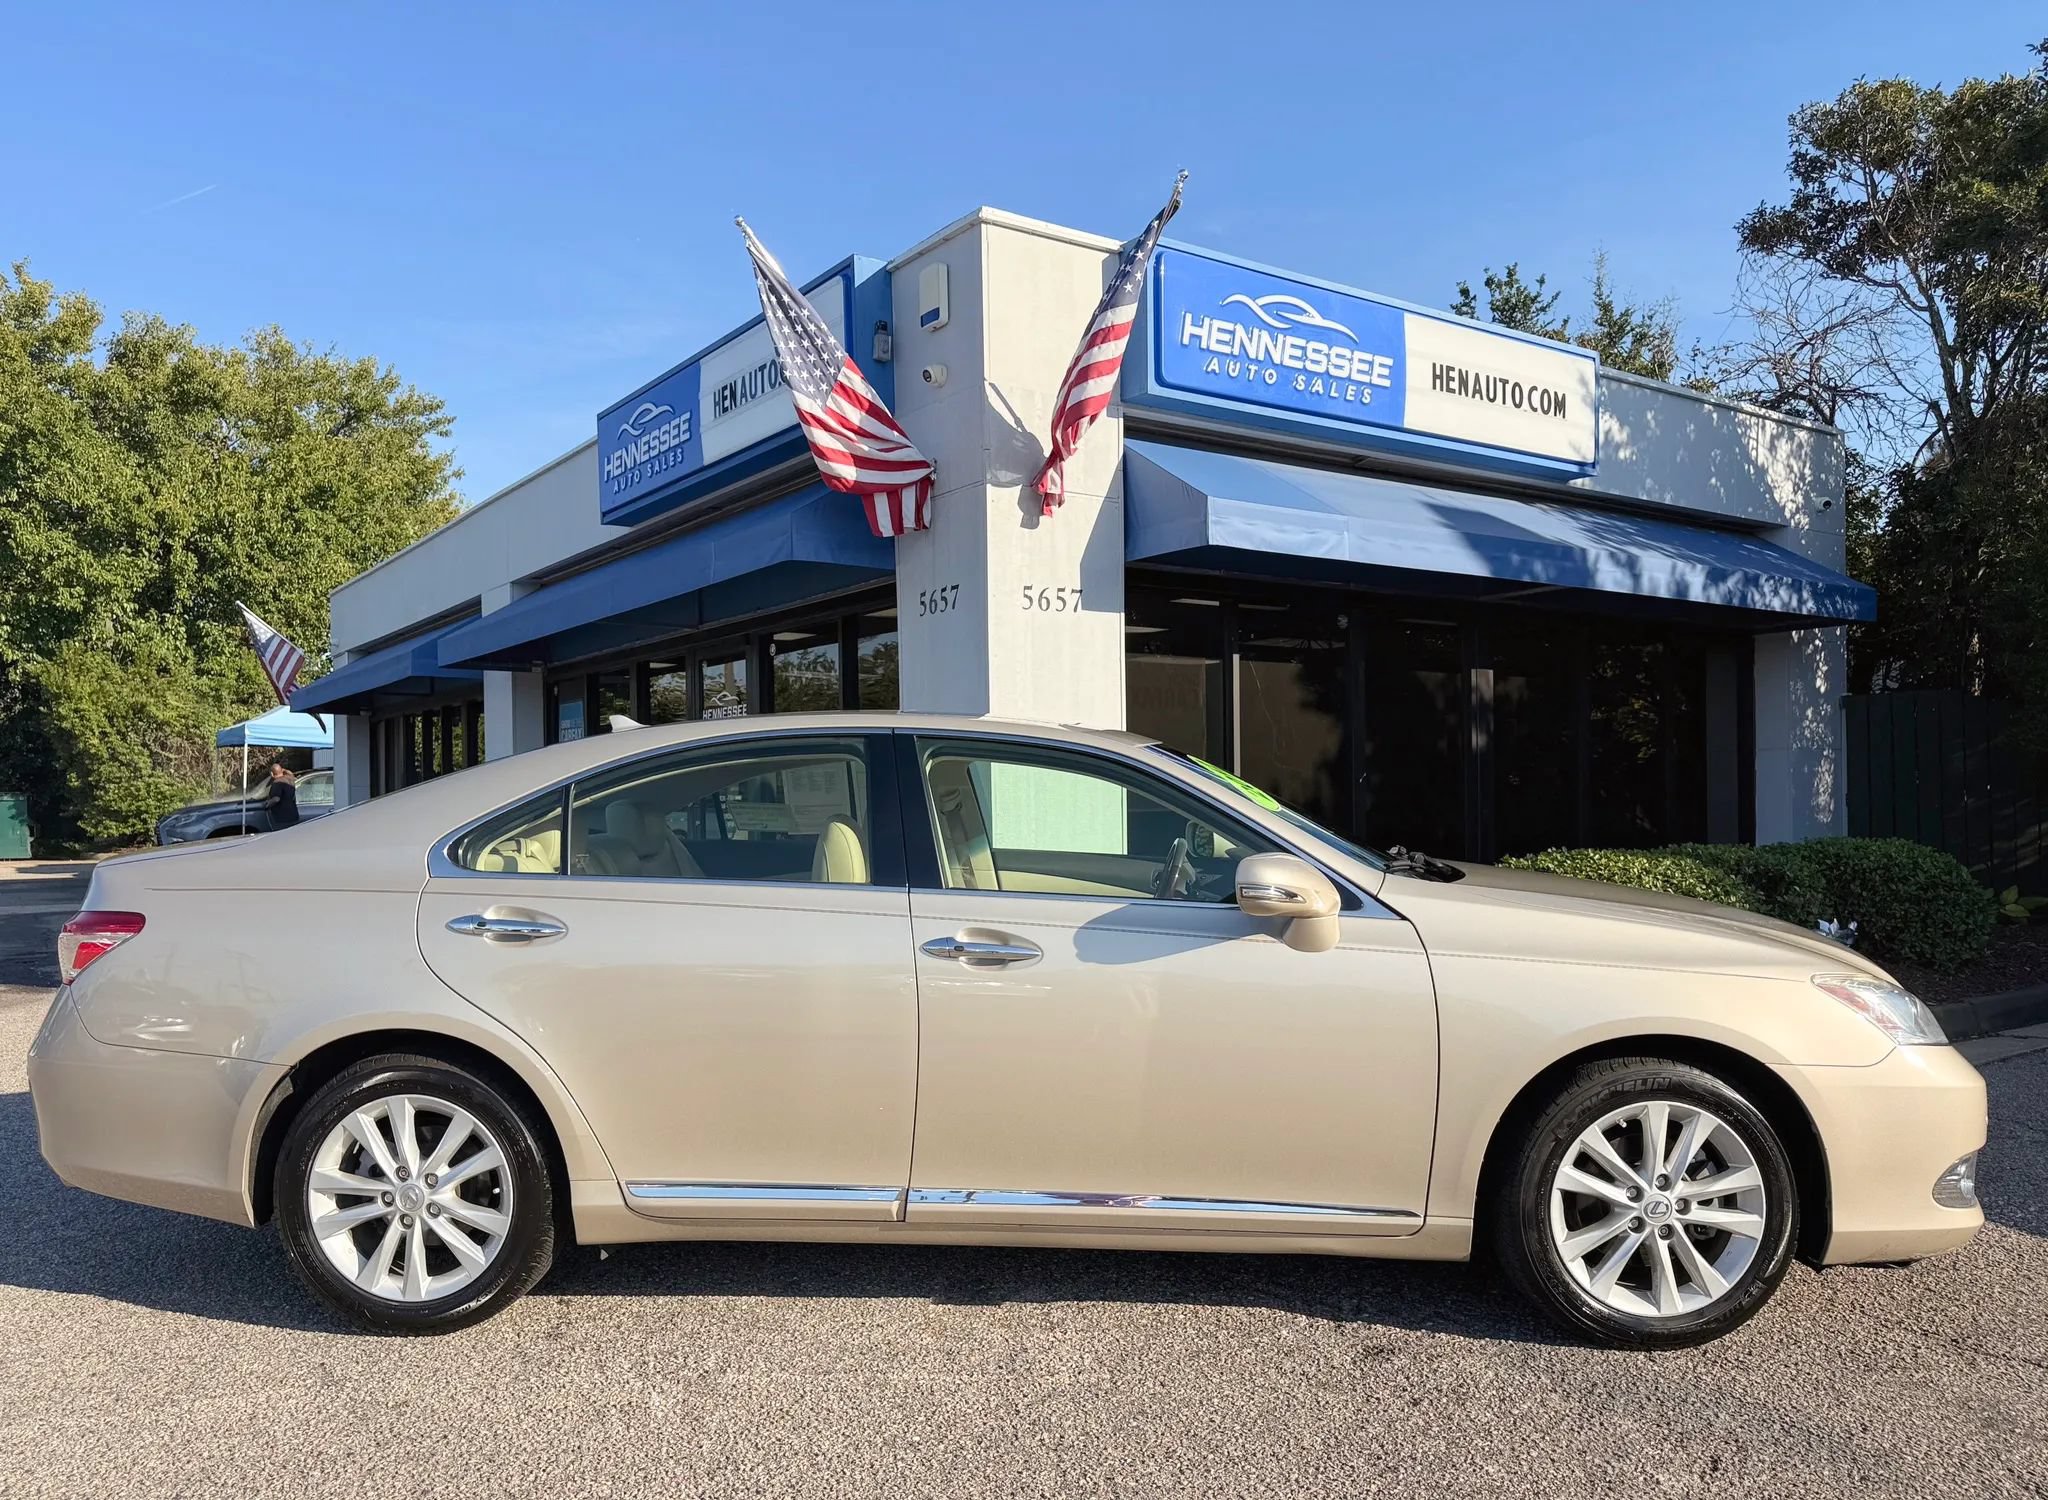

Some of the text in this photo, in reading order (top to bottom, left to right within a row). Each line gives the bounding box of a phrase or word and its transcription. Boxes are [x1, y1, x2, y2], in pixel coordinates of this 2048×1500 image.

[1180, 311, 1394, 388] HENNESSEE
[1203, 356, 1373, 406] AUTO SALES
[603, 410, 692, 483] HENNESSEE
[613, 447, 684, 494] AUTO SALES
[919, 584, 960, 617] 5657
[1022, 585, 1083, 613] 5657
[702, 704, 748, 721] HENNESSEE
